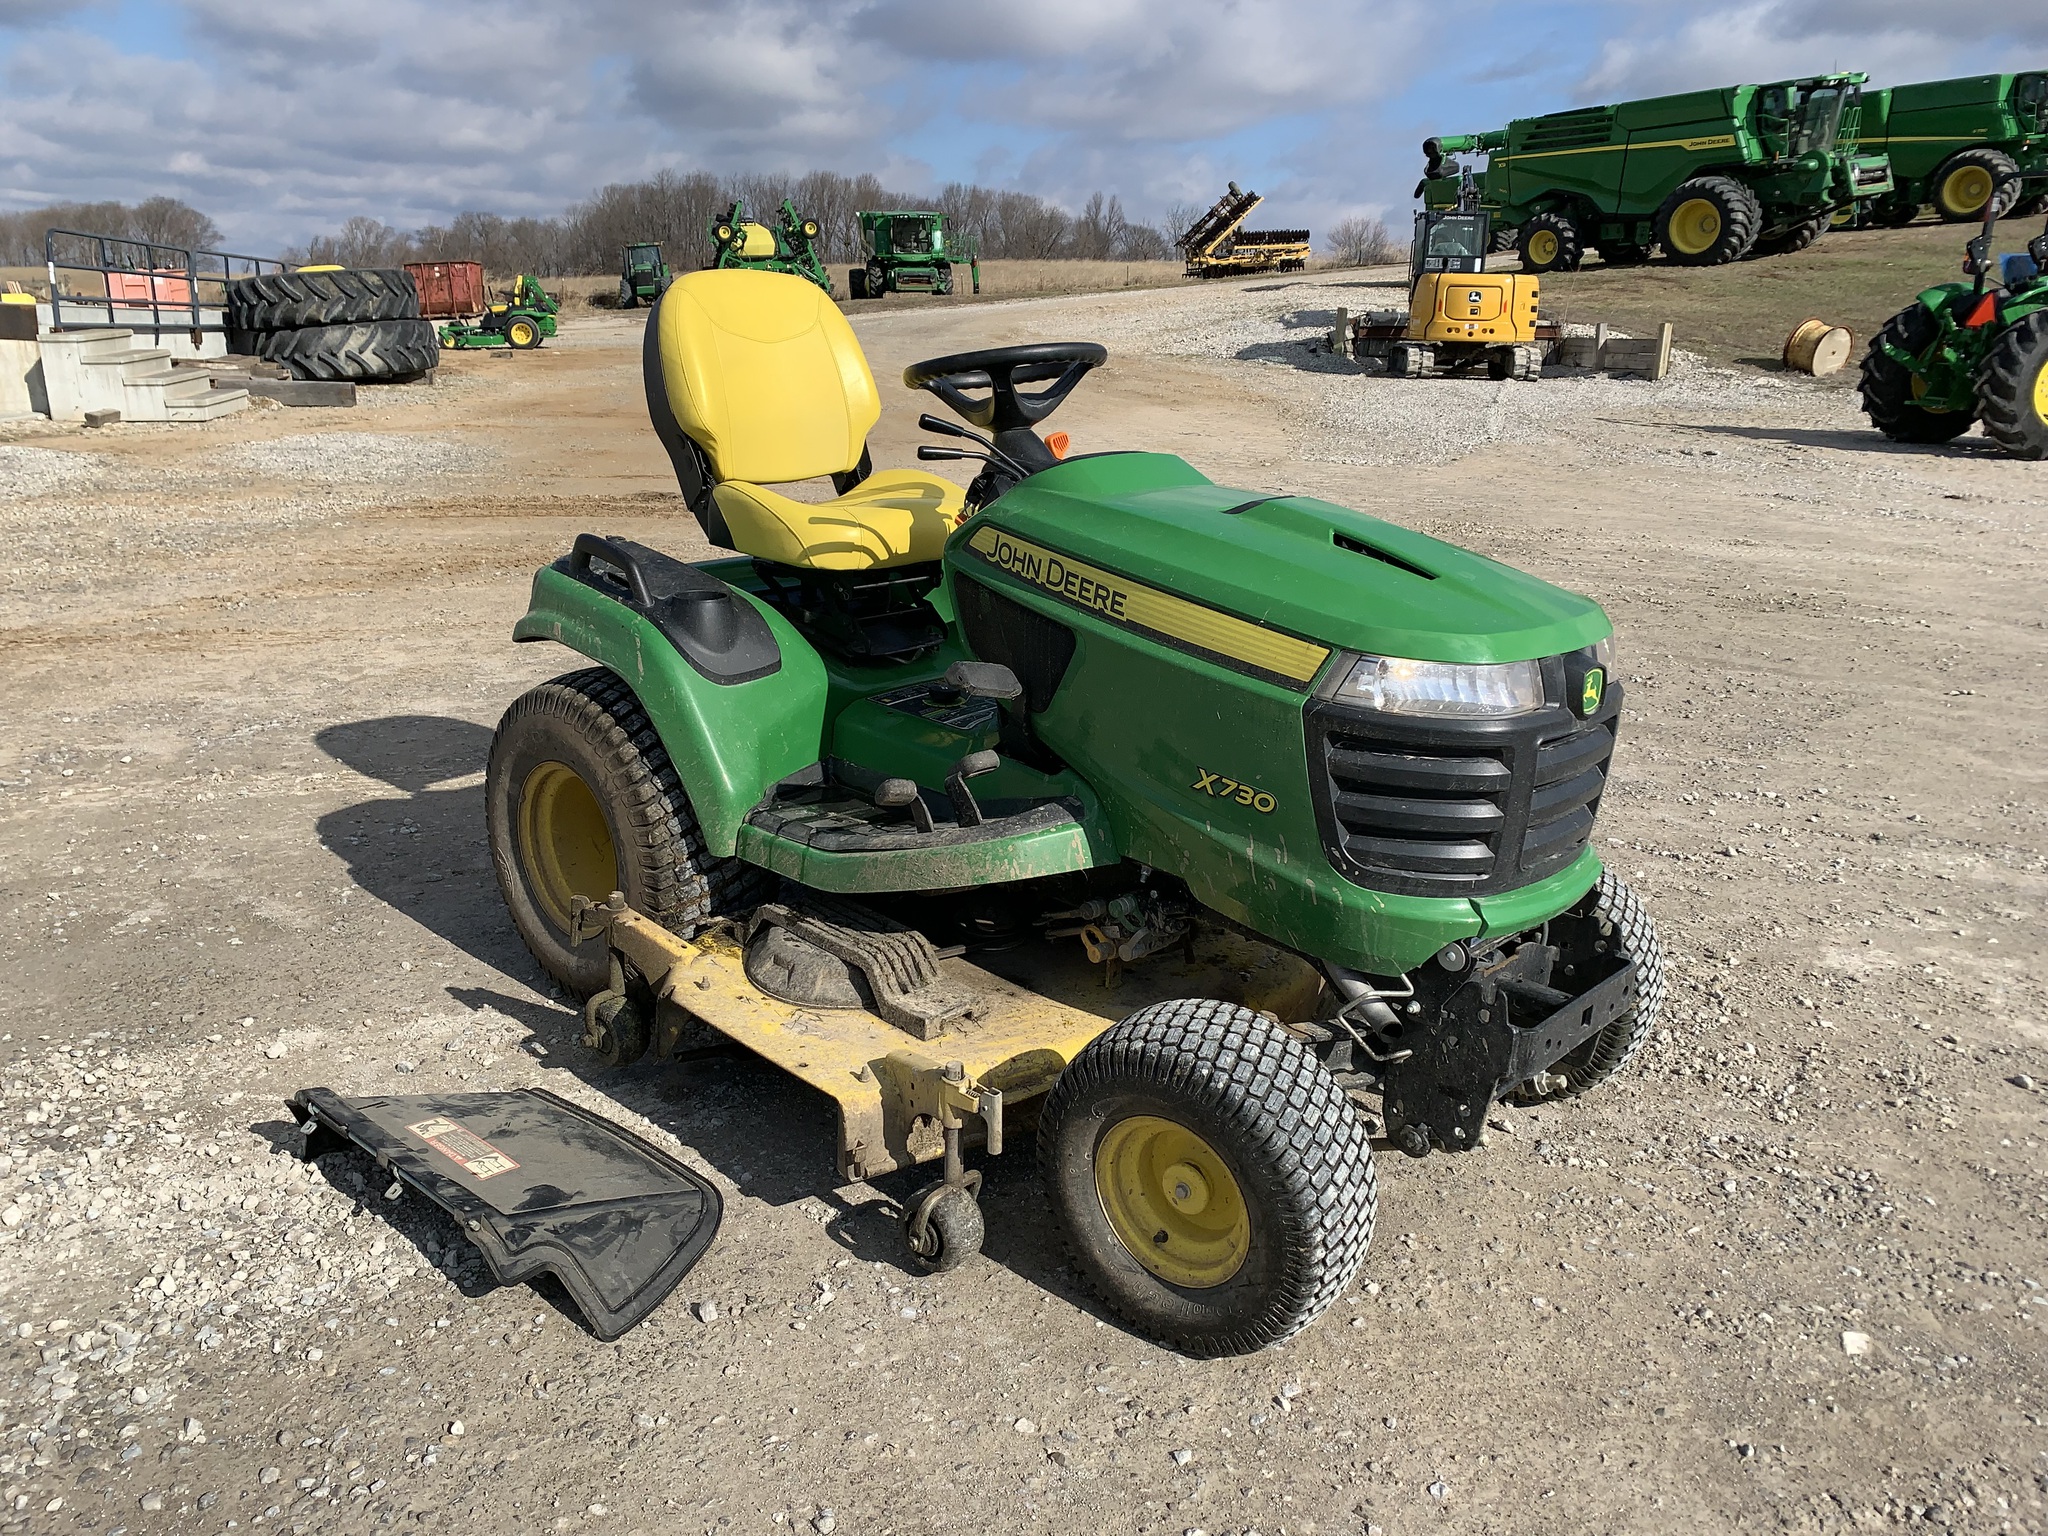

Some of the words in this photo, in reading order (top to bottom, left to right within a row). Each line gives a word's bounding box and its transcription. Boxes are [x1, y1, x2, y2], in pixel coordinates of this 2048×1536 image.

[986, 534, 1043, 580] JOHN
[1046, 557, 1128, 618] DEERE
[1191, 766, 1276, 813] X730
[429, 1140, 456, 1158] DANGER
